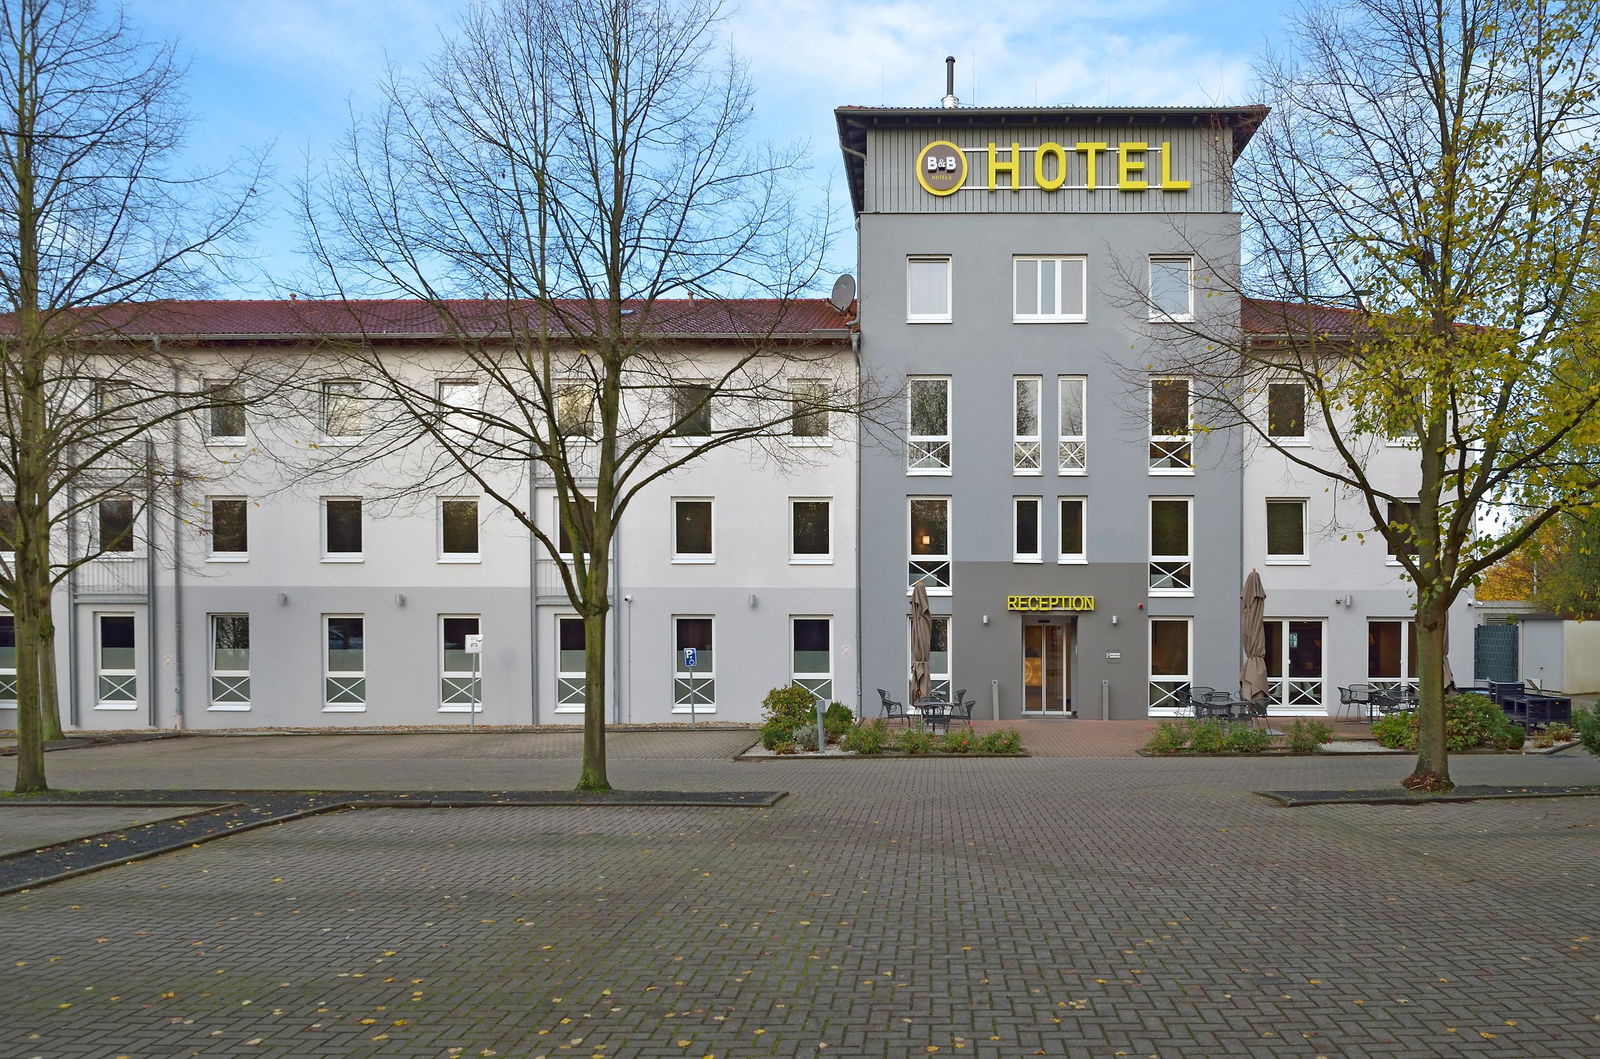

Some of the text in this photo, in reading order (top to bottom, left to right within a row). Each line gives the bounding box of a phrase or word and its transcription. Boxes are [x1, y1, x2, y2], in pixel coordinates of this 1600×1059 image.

[927, 156, 957, 172] B&B
[988, 142, 1191, 192] HOTEL
[1007, 595, 1095, 612] RECEPTION
[686, 649, 693, 659] P
